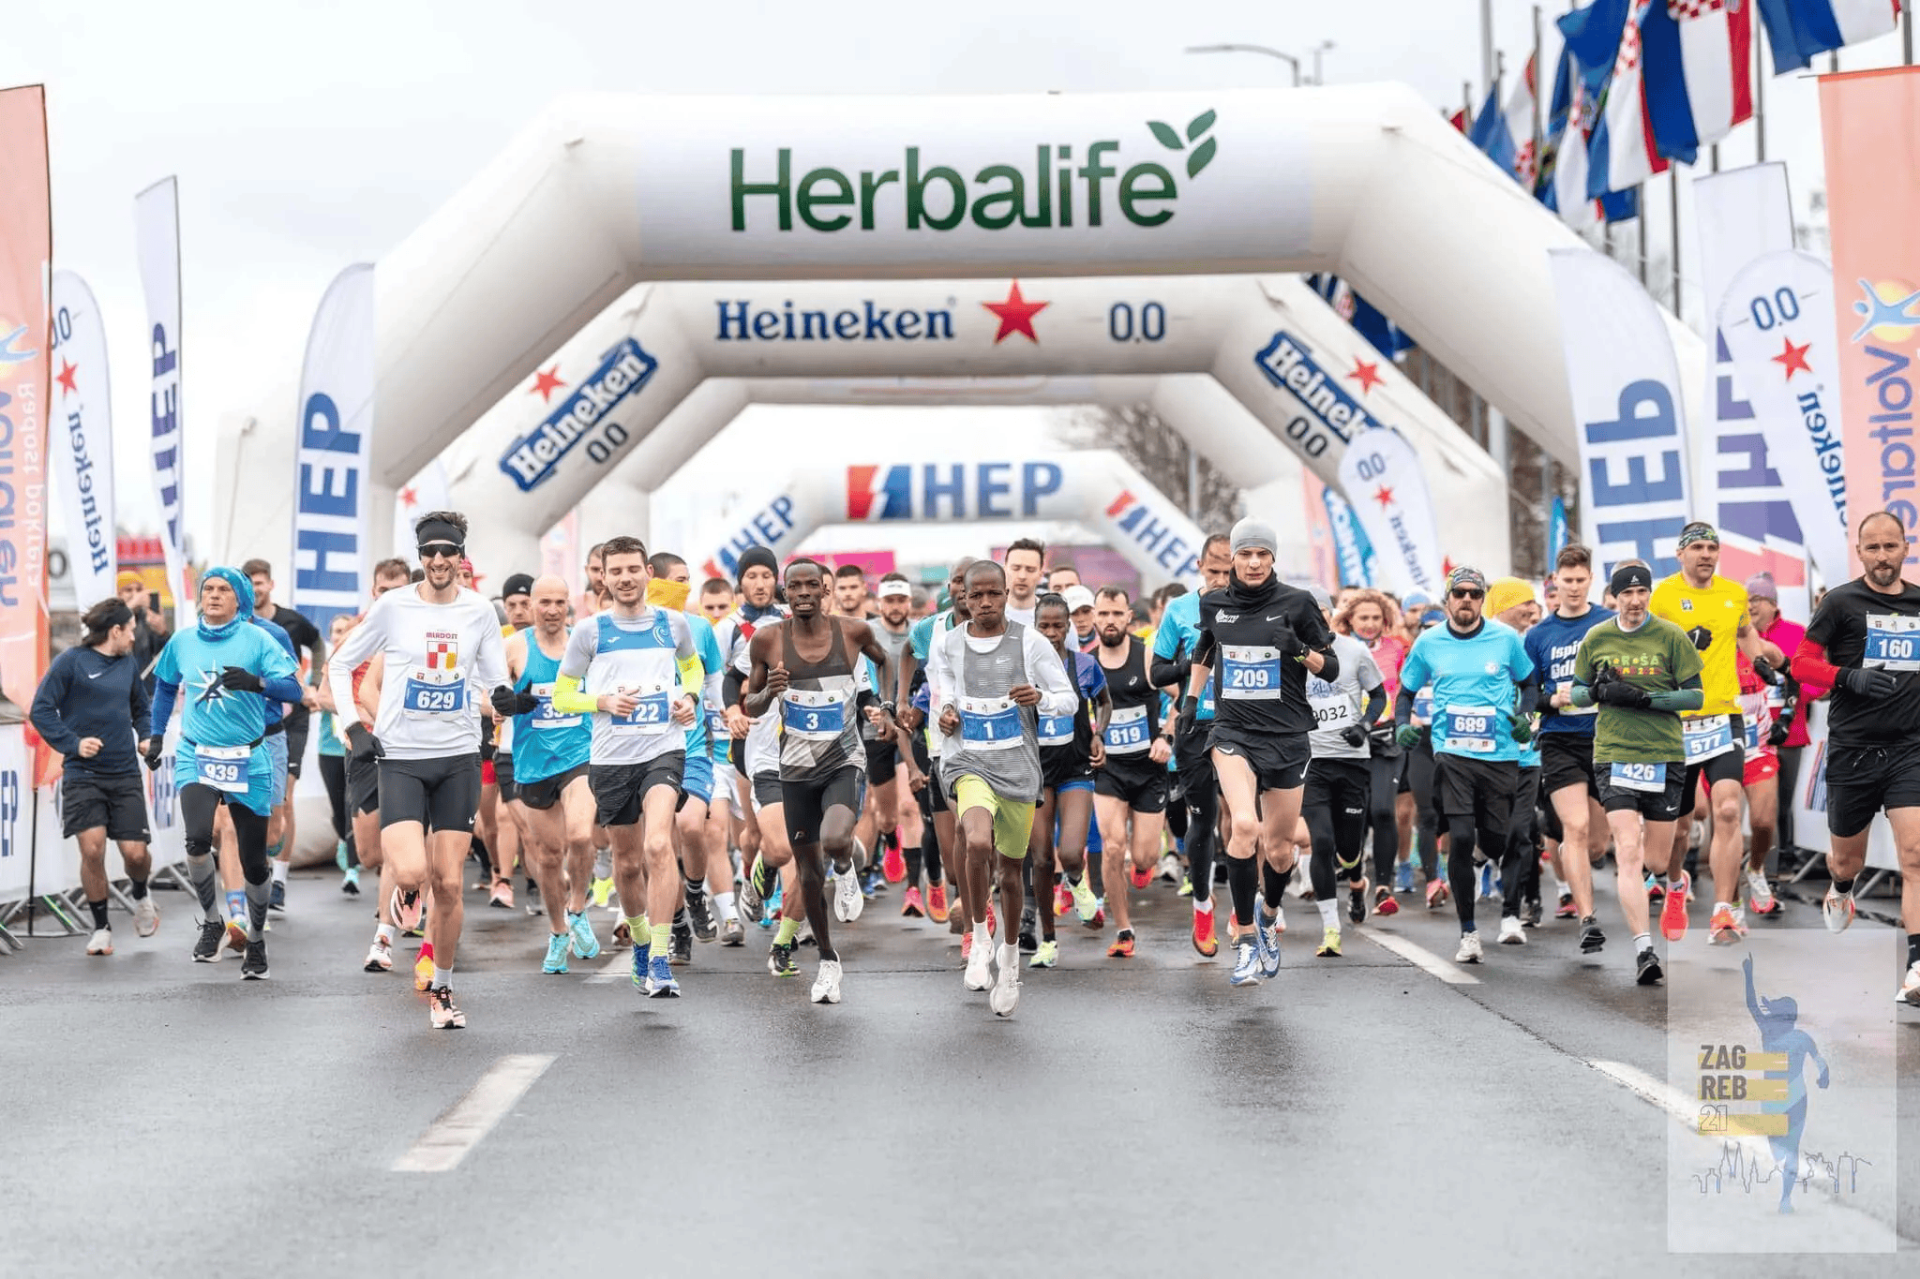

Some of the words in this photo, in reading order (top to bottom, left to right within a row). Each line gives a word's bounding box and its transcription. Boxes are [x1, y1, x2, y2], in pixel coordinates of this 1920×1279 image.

[730, 140, 1179, 232] Herbalife
[716, 301, 954, 341] Heineken
[1109, 302, 1166, 344] 0.0
[507, 354, 650, 482] Heineken
[296, 391, 362, 592] HEP
[923, 461, 1063, 519] HEP
[1878, 638, 1913, 658] 160
[1232, 669, 1269, 688] 209
[417, 690, 455, 709] 629
[806, 712, 819, 729] 3
[983, 721, 994, 739] 1
[1044, 720, 1057, 736] 4
[1454, 715, 1487, 733] 689
[1110, 726, 1141, 745] 819
[1691, 734, 1722, 753] 577
[204, 763, 239, 781] 939
[1621, 763, 1656, 781] 426
